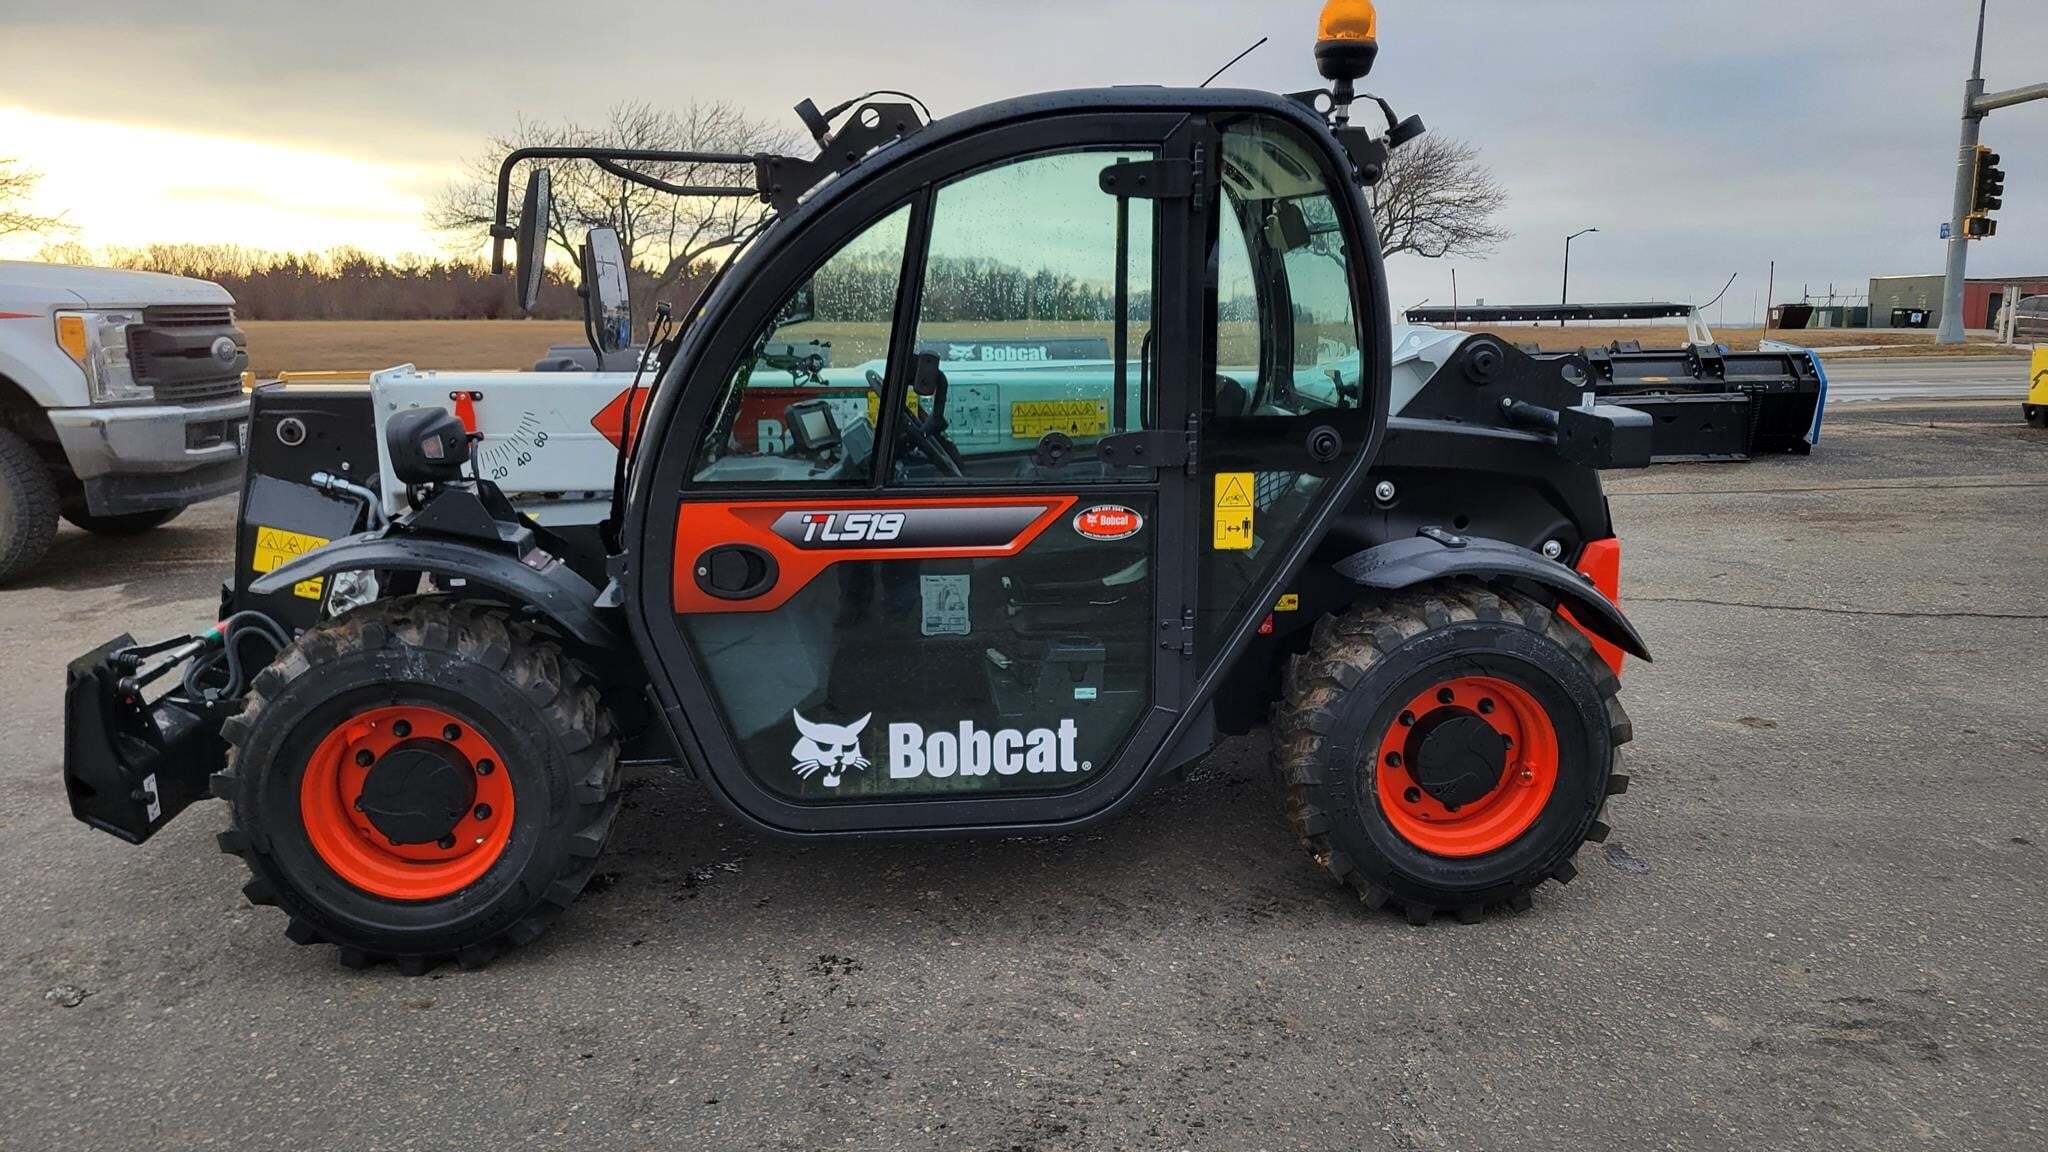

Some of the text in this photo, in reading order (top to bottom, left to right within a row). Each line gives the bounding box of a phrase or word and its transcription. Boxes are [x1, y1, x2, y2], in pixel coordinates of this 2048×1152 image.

[981, 345, 1048, 361] Bobcat
[534, 432, 548, 447] 60
[517, 452, 531, 466] 40
[491, 466, 508, 480] 20
[802, 514, 905, 541] TL519
[1100, 514, 1129, 526] Bobcat
[889, 718, 1078, 779] Bobcat
